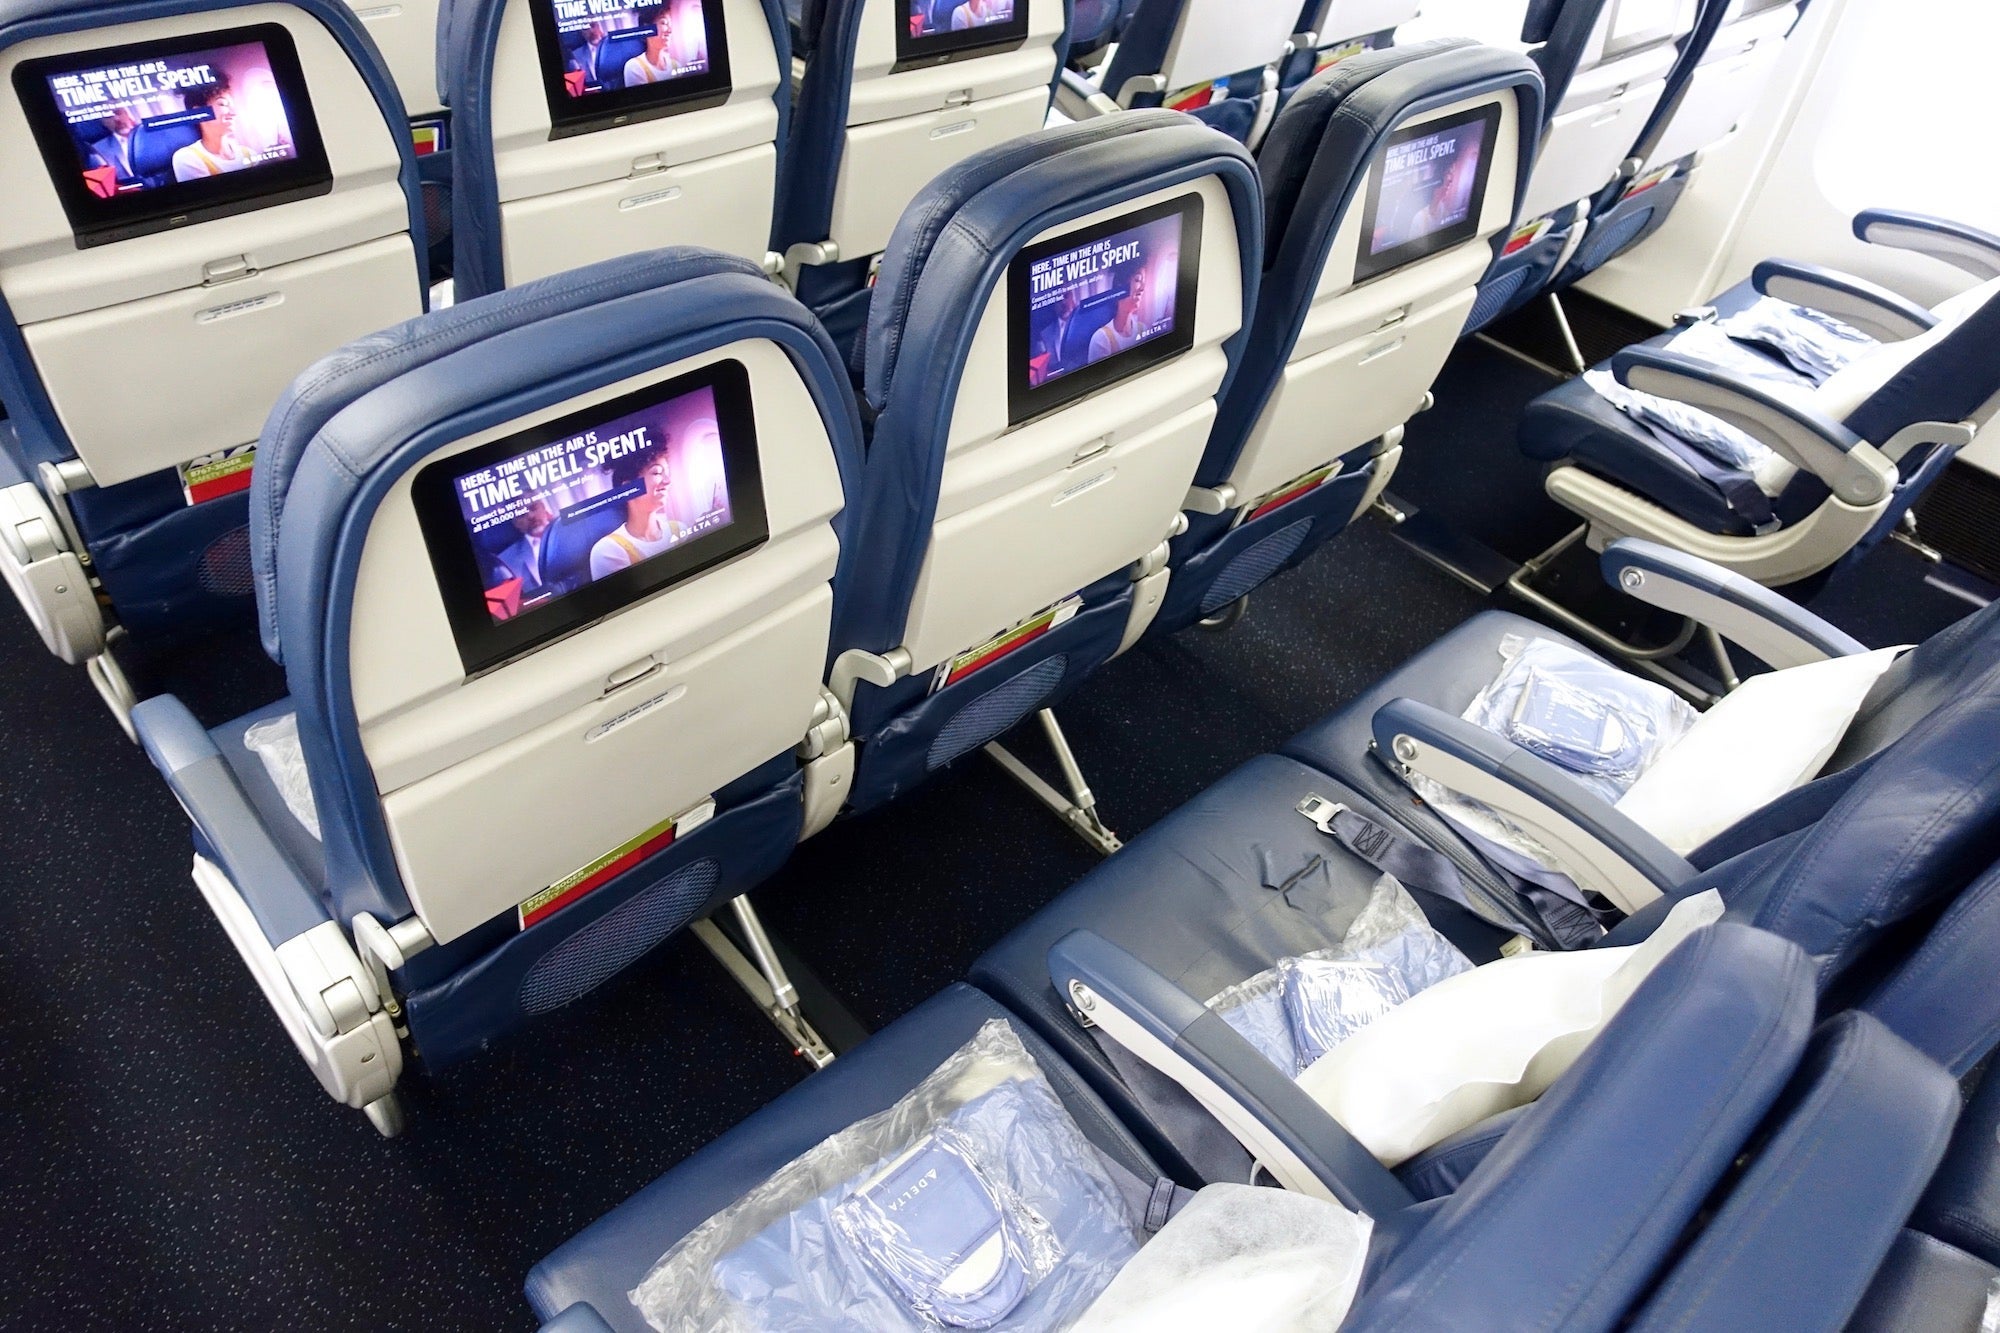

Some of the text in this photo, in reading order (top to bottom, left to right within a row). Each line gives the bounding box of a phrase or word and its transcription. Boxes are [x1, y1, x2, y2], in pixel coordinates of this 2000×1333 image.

[555, 0, 588, 19] TIME
[56, 83, 108, 107] TIME
[106, 75, 158, 99] WELL
[157, 65, 216, 91] SPENT.
[81, 70, 108, 84] TIME
[107, 69, 120, 79] IN
[119, 66, 140, 78] THE
[140, 62, 157, 75] AIR
[156, 60, 167, 72] IS
[1385, 154, 1407, 174] TIME
[1407, 148, 1428, 167] WELL
[1429, 139, 1456, 160] SPENT.
[1032, 240, 1111, 275] HERE, TIME IN THE AIR IS
[1032, 241, 1140, 294] TIME WELL SPENT.
[1142, 325, 1161, 338] DELTA
[460, 432, 598, 491] HERE, TIME IN THE AIR IS
[463, 426, 652, 513] TIME WELL SPENT.
[471, 510, 498, 525] Connect
[498, 507, 505, 515] to
[505, 499, 524, 512] Wi-Fi
[524, 497, 531, 505] to
[473, 524, 482, 533] all
[482, 521, 490, 530] at
[680, 520, 711, 538] DELTA
[564, 852, 624, 892] INFORMATION
[888, 1179, 929, 1212] DELTA
